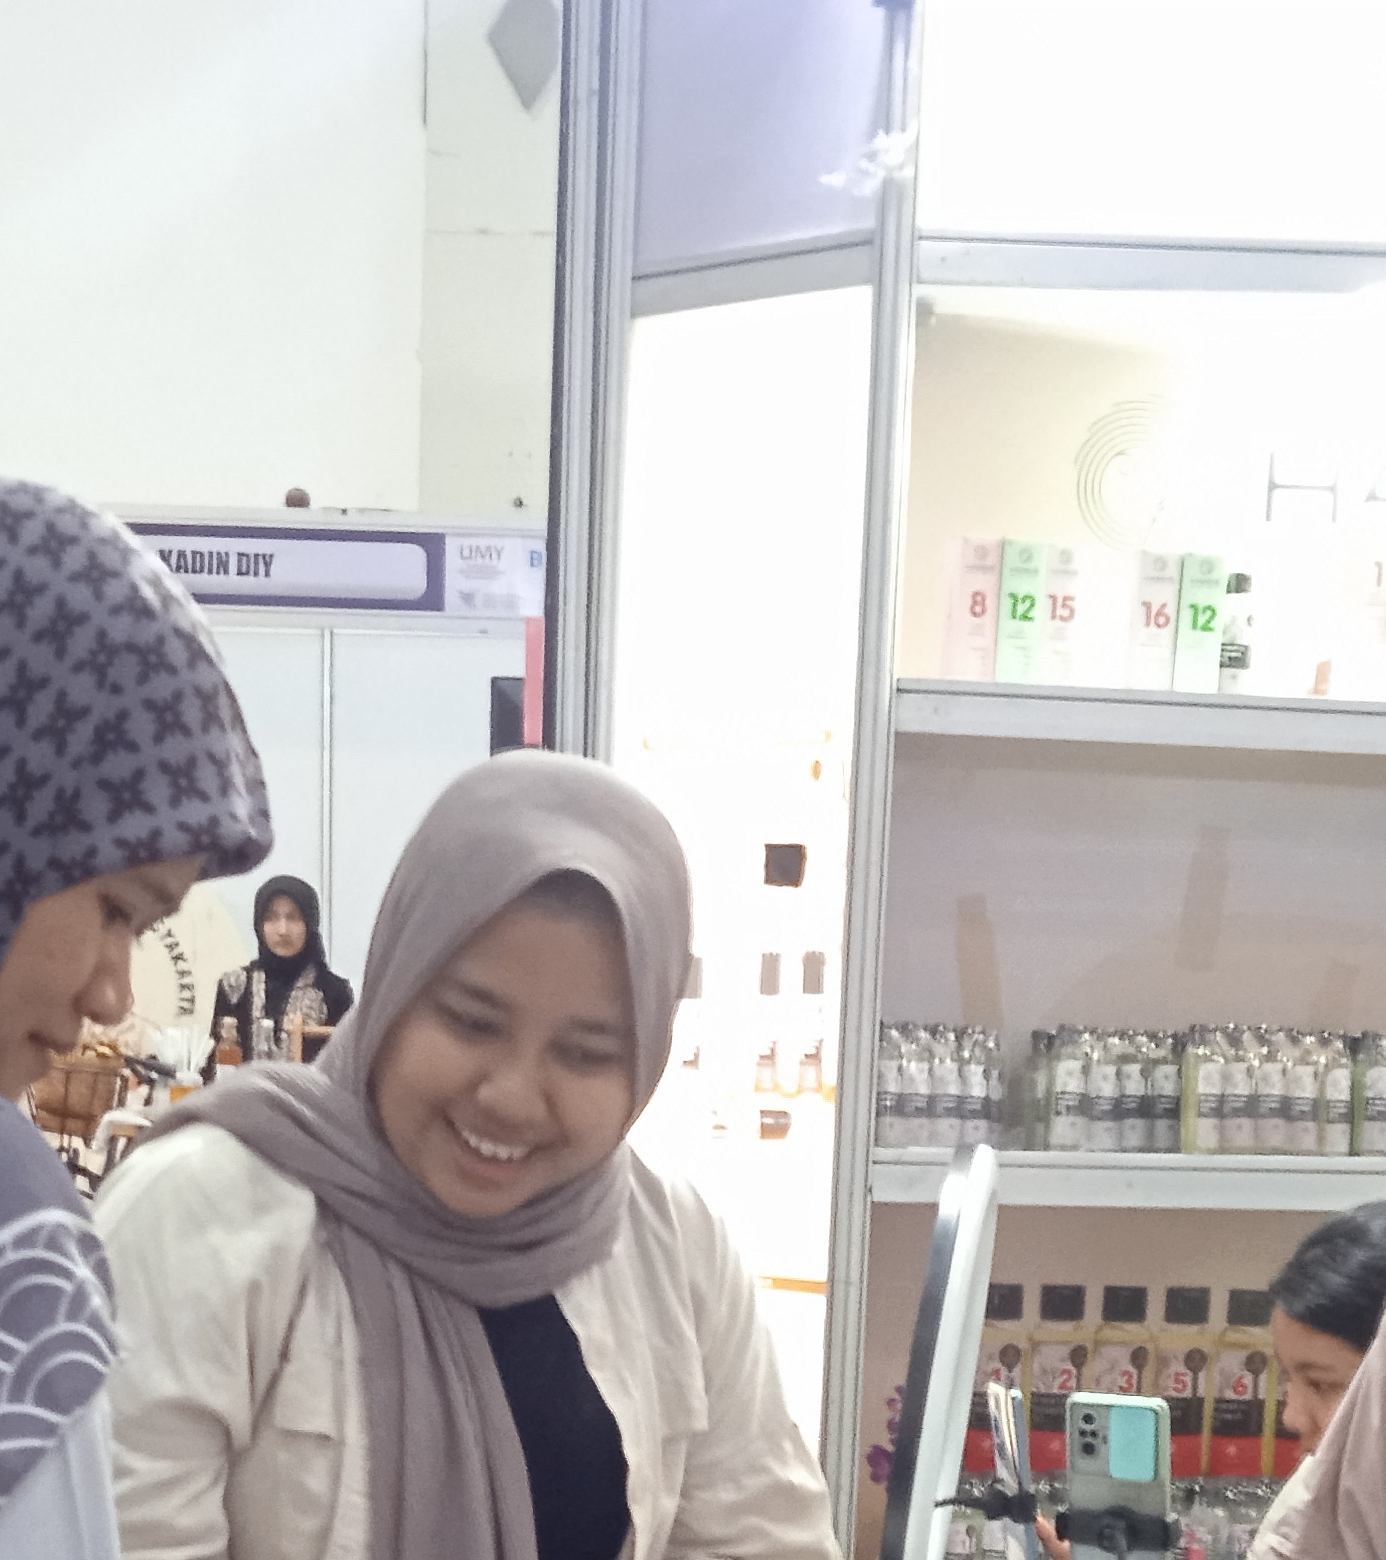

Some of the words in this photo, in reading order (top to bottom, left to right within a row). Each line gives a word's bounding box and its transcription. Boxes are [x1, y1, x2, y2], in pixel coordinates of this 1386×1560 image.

[237, 552, 274, 578] DIY
[459, 544, 505, 563] UMY
[969, 591, 987, 618] 8
[1008, 591, 1036, 622] 12
[1049, 593, 1076, 623] 15
[1141, 601, 1171, 629] 16
[1189, 603, 1218, 632] 12
[1058, 1368, 1075, 1392] 2
[1119, 1369, 1134, 1393] 3
[1172, 1370, 1189, 1394] 5
[1232, 1375, 1248, 1397] 6
